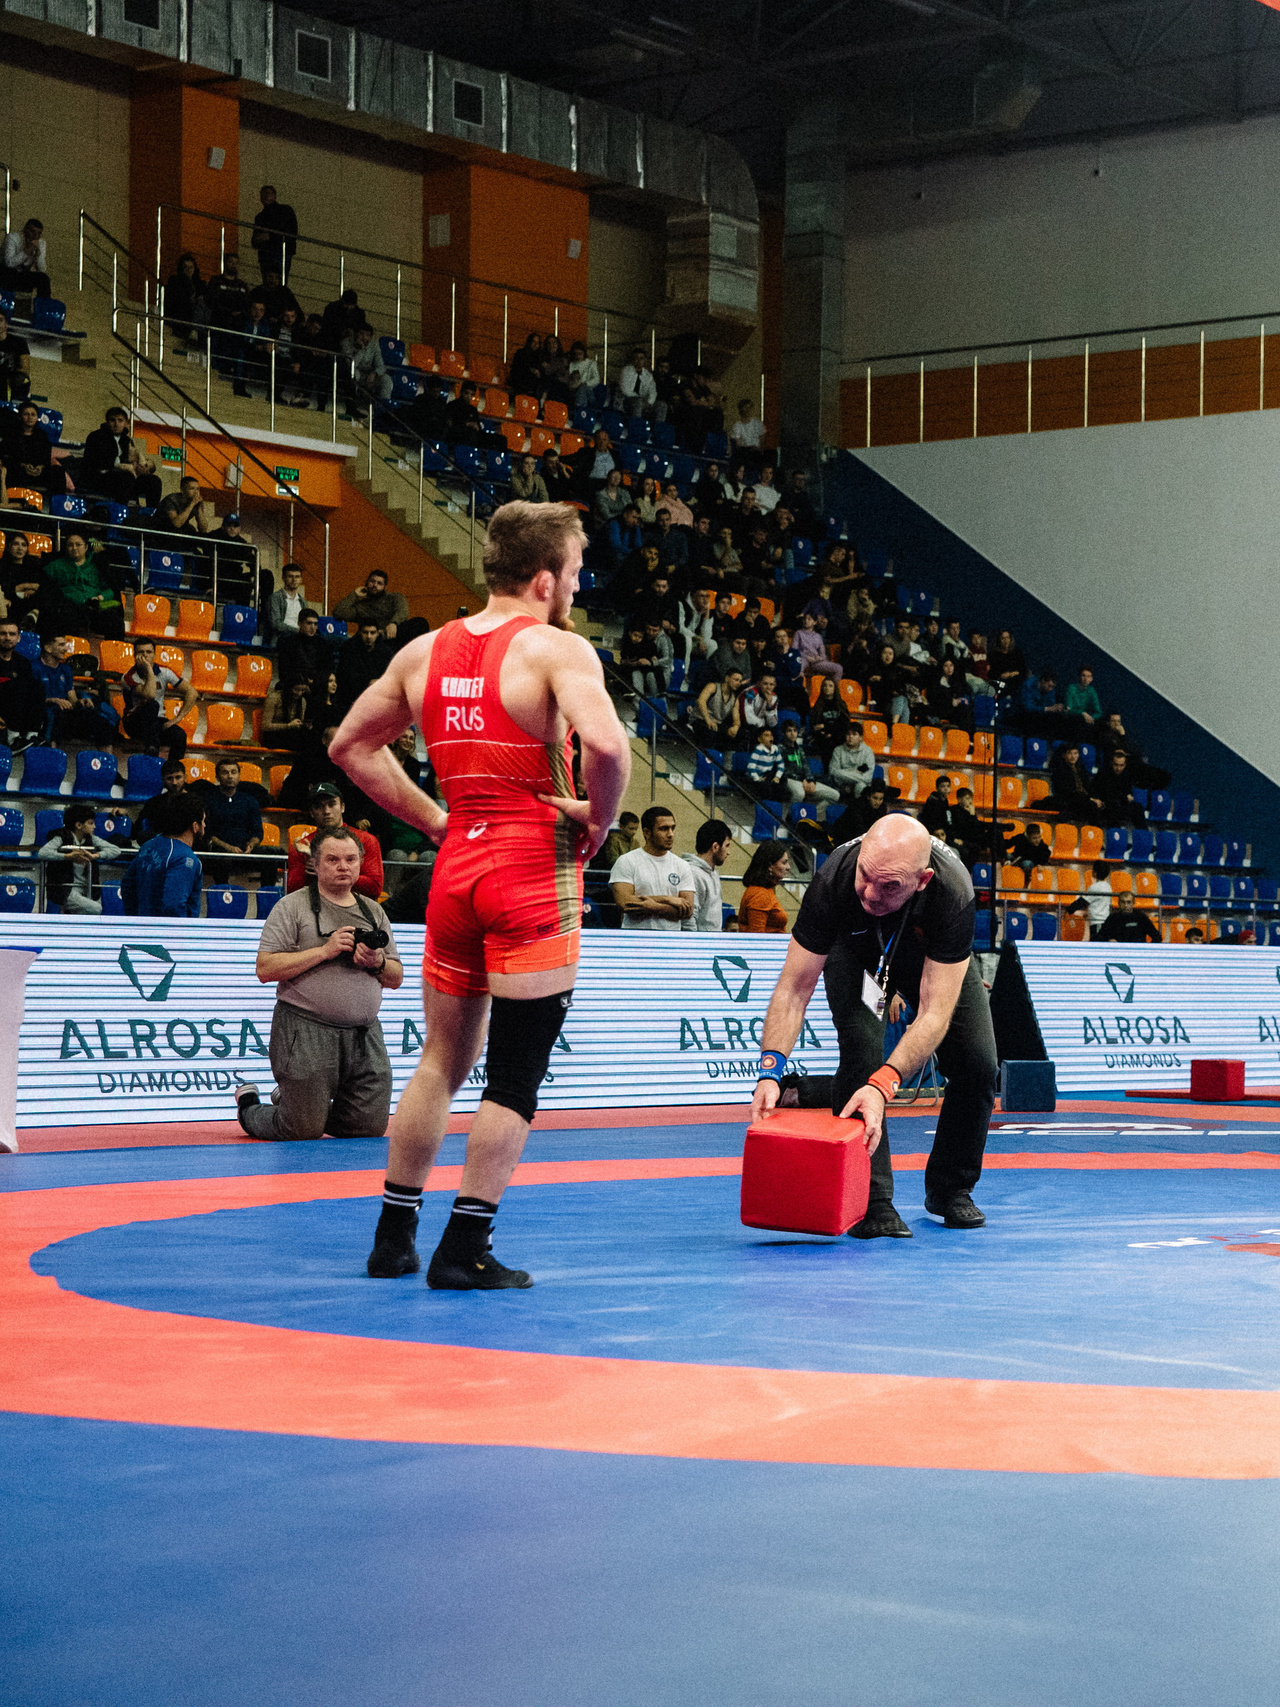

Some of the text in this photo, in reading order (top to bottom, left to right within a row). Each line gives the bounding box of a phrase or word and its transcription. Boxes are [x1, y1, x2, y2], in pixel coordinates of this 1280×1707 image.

[445, 706, 485, 732] RUS
[60, 1018, 269, 1059] ALROSA
[1083, 1015, 1191, 1044] ALROSA
[1104, 1053, 1182, 1068] DIAMONDS
[98, 1069, 246, 1094] DIAMONDS
